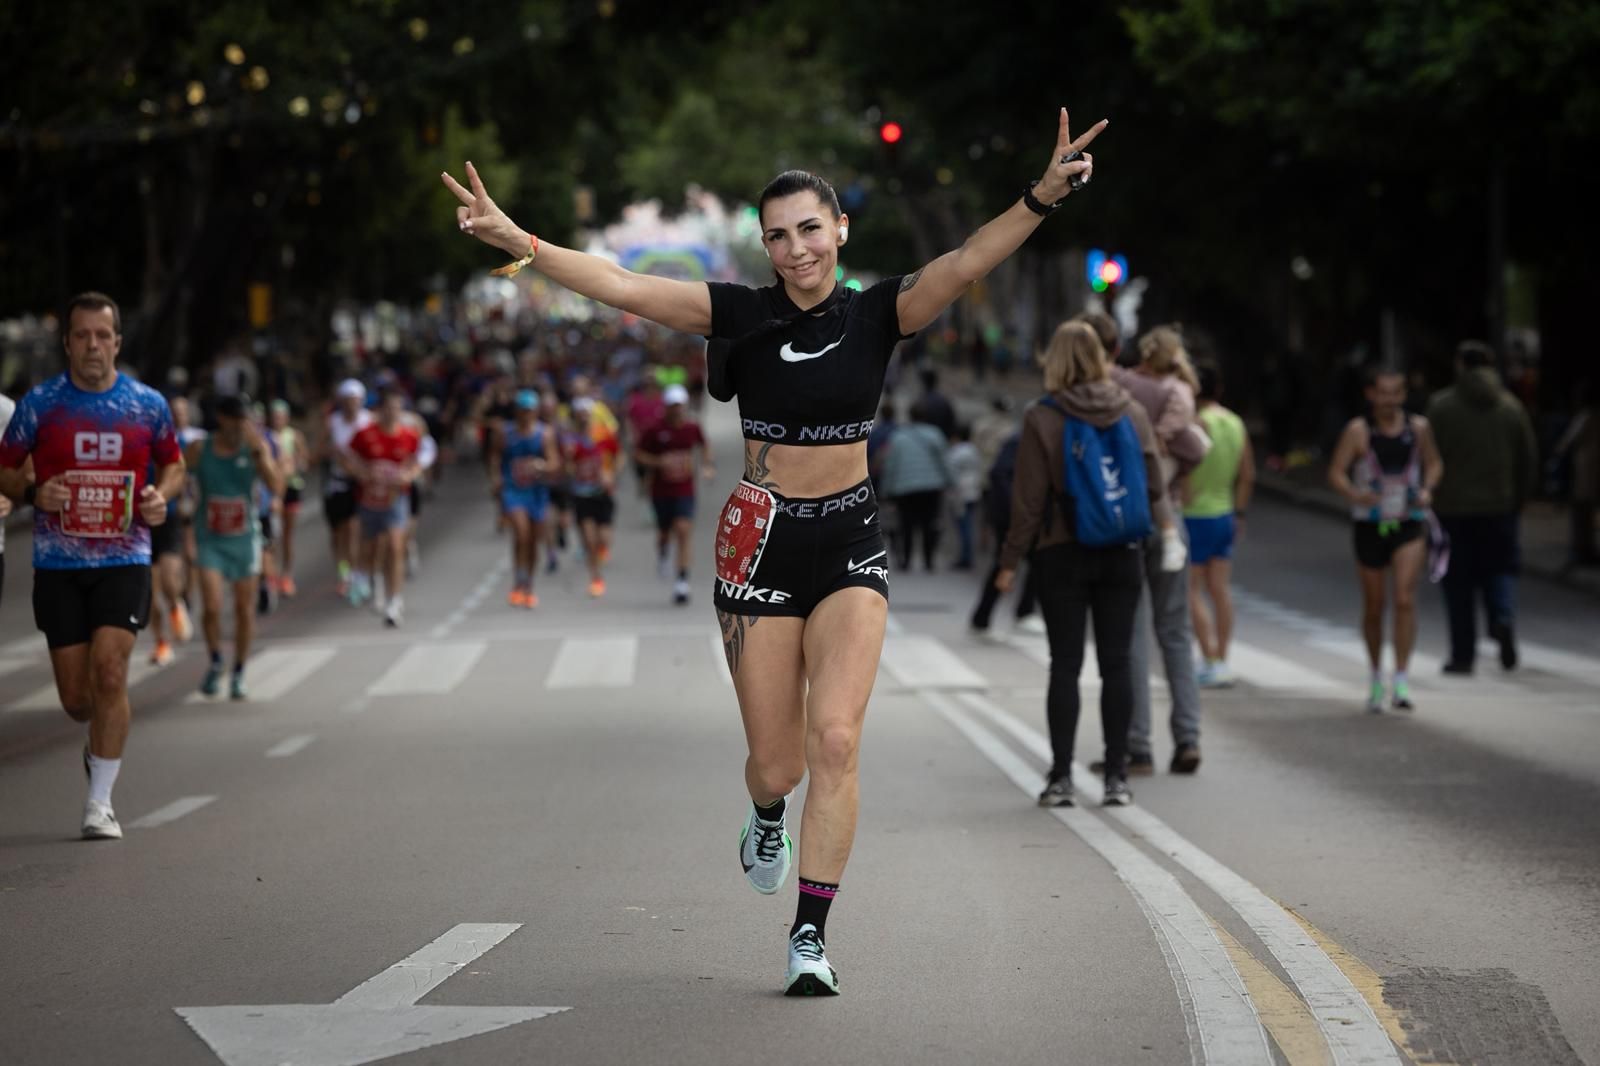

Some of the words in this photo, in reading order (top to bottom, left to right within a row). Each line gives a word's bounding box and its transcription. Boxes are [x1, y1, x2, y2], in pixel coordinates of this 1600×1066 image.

[743, 419, 786, 439] PRO
[798, 423, 859, 440] NIKE
[74, 432, 123, 461] CB
[78, 487, 113, 501] 8233
[821, 486, 869, 517] PRO
[720, 582, 793, 604] NIKE
